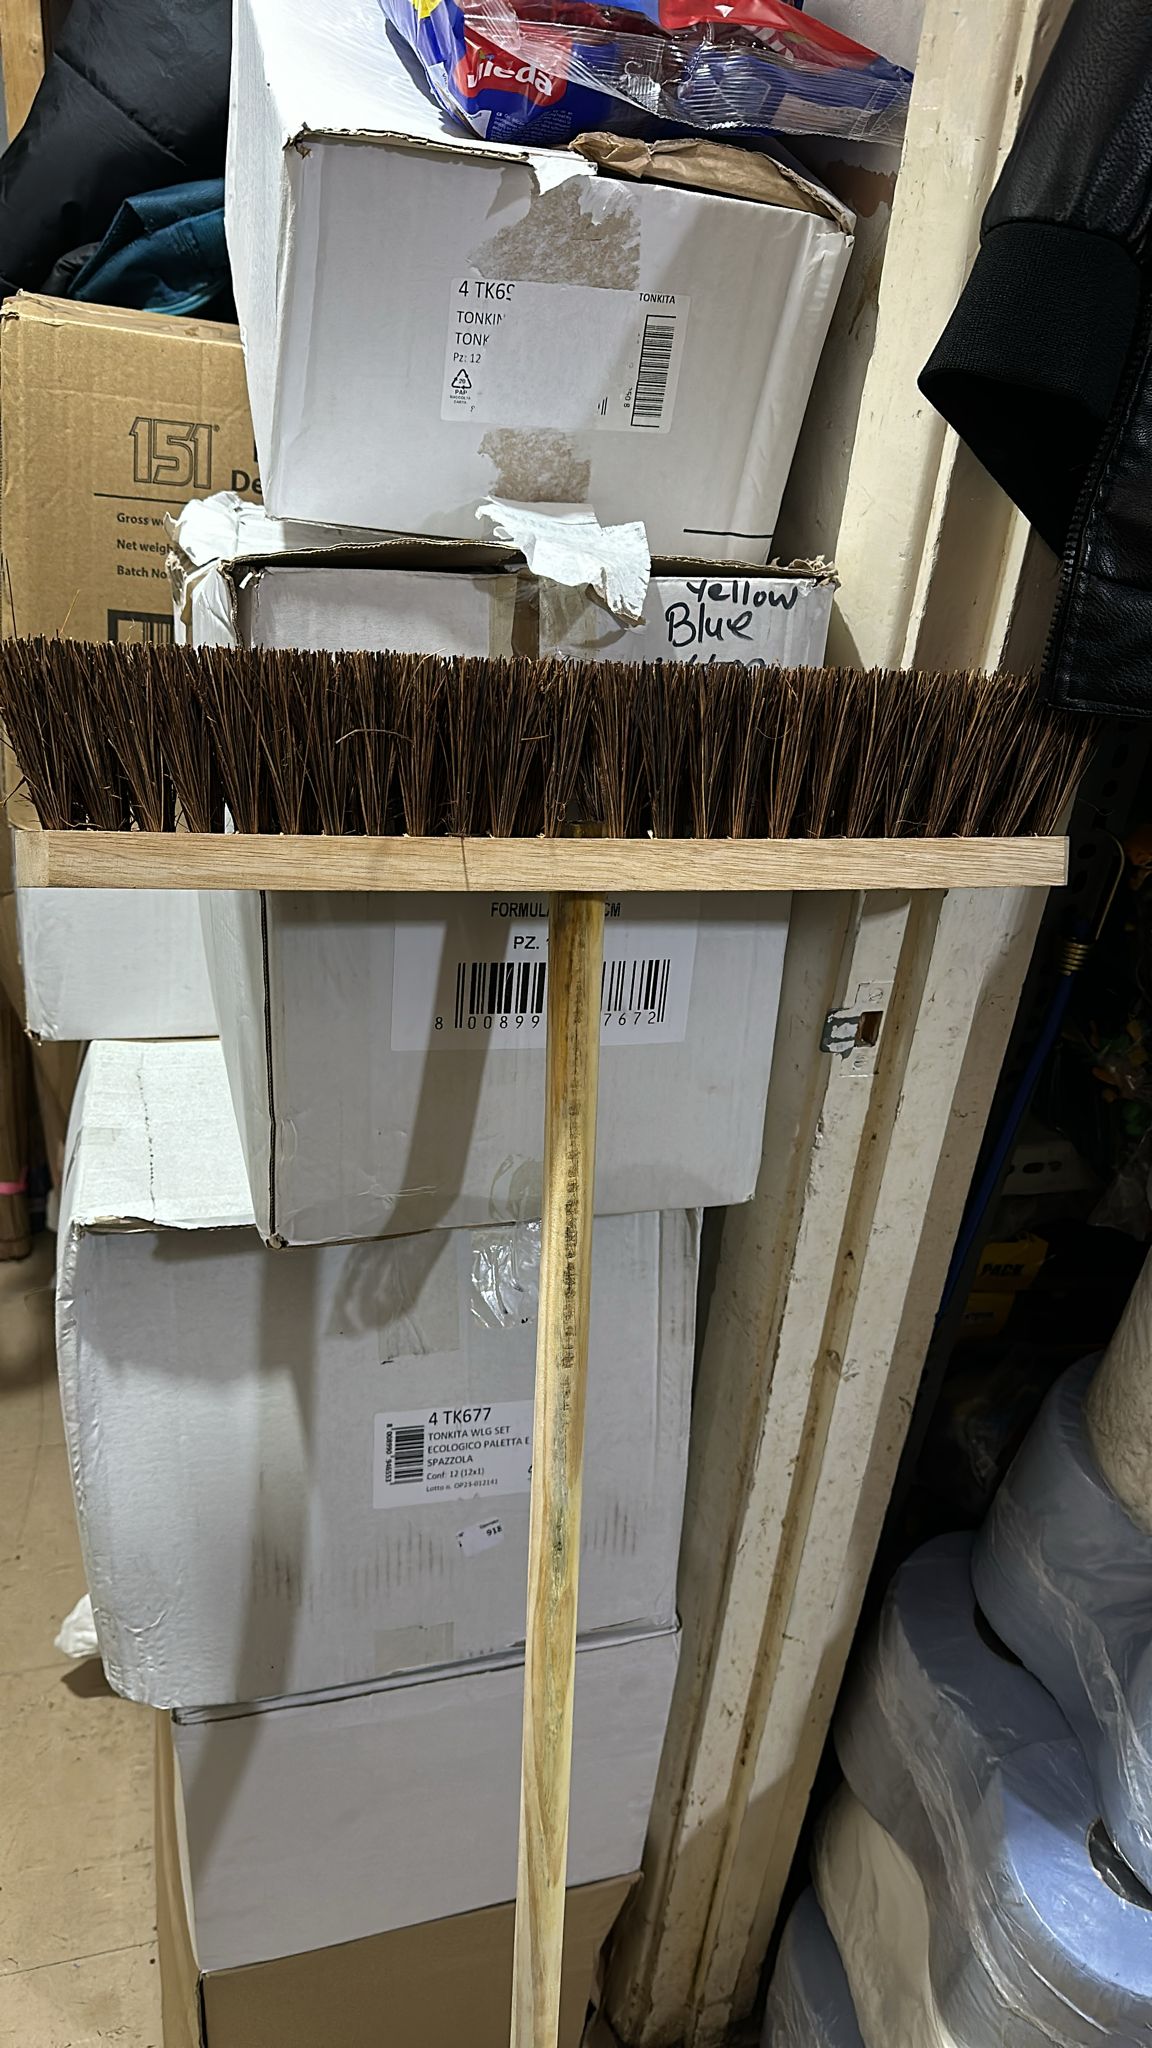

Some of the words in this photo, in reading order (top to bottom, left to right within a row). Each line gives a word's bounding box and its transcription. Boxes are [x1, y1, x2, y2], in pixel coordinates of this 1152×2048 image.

[459, 280, 469, 297] 4
[640, 293, 676, 304] TONKITA
[117, 513, 149, 525] Gross
[117, 540, 137, 550] Net
[140, 543, 173, 555] weigh
[117, 565, 148, 577] Batch
[665, 602, 753, 647] Blue
[513, 936, 539, 949] PZ.
[428, 1412, 438, 1425] 4
[443, 1407, 492, 1424] TK677
[428, 1430, 468, 1441] TONKITA
[471, 1426, 492, 1437] WLG
[494, 1425, 511, 1434] SET
[427, 1441, 482, 1454] ECOLOGICO
[483, 1437, 523, 1449] PALETTA
[427, 1454, 473, 1467] SPAZZOLA
[450, 1469, 459, 1478] 12
